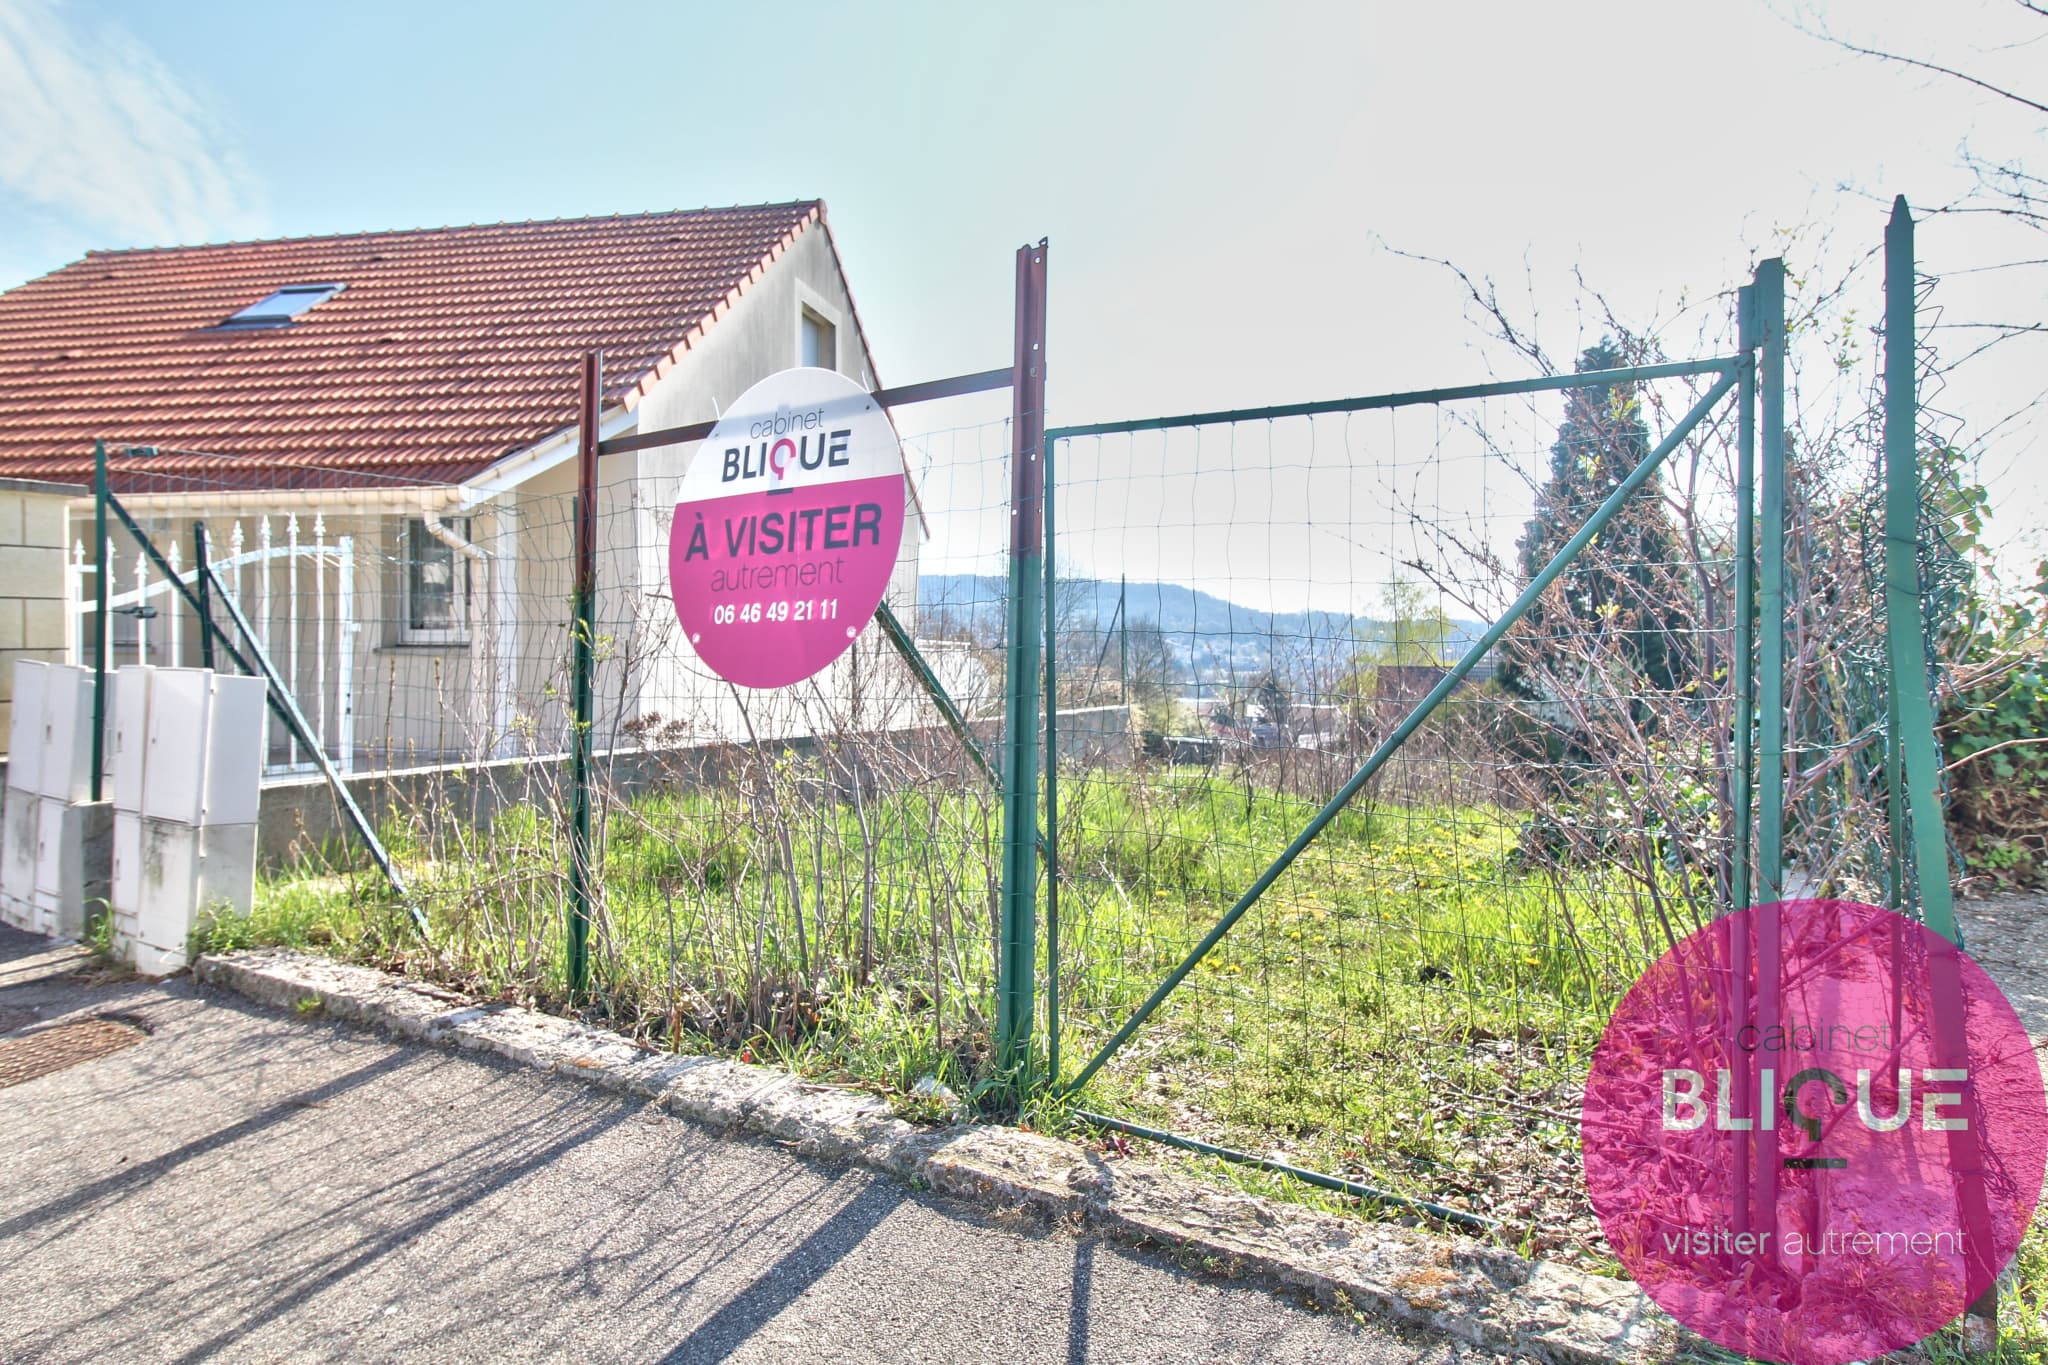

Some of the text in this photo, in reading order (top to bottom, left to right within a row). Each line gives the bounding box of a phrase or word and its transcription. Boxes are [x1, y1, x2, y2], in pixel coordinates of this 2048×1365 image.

[750, 407, 825, 440] cabinet
[722, 429, 852, 482] BLIQUE
[684, 503, 882, 563] À VISITER
[710, 557, 845, 593] autrement
[714, 598, 838, 625] 06 46 49 21 11
